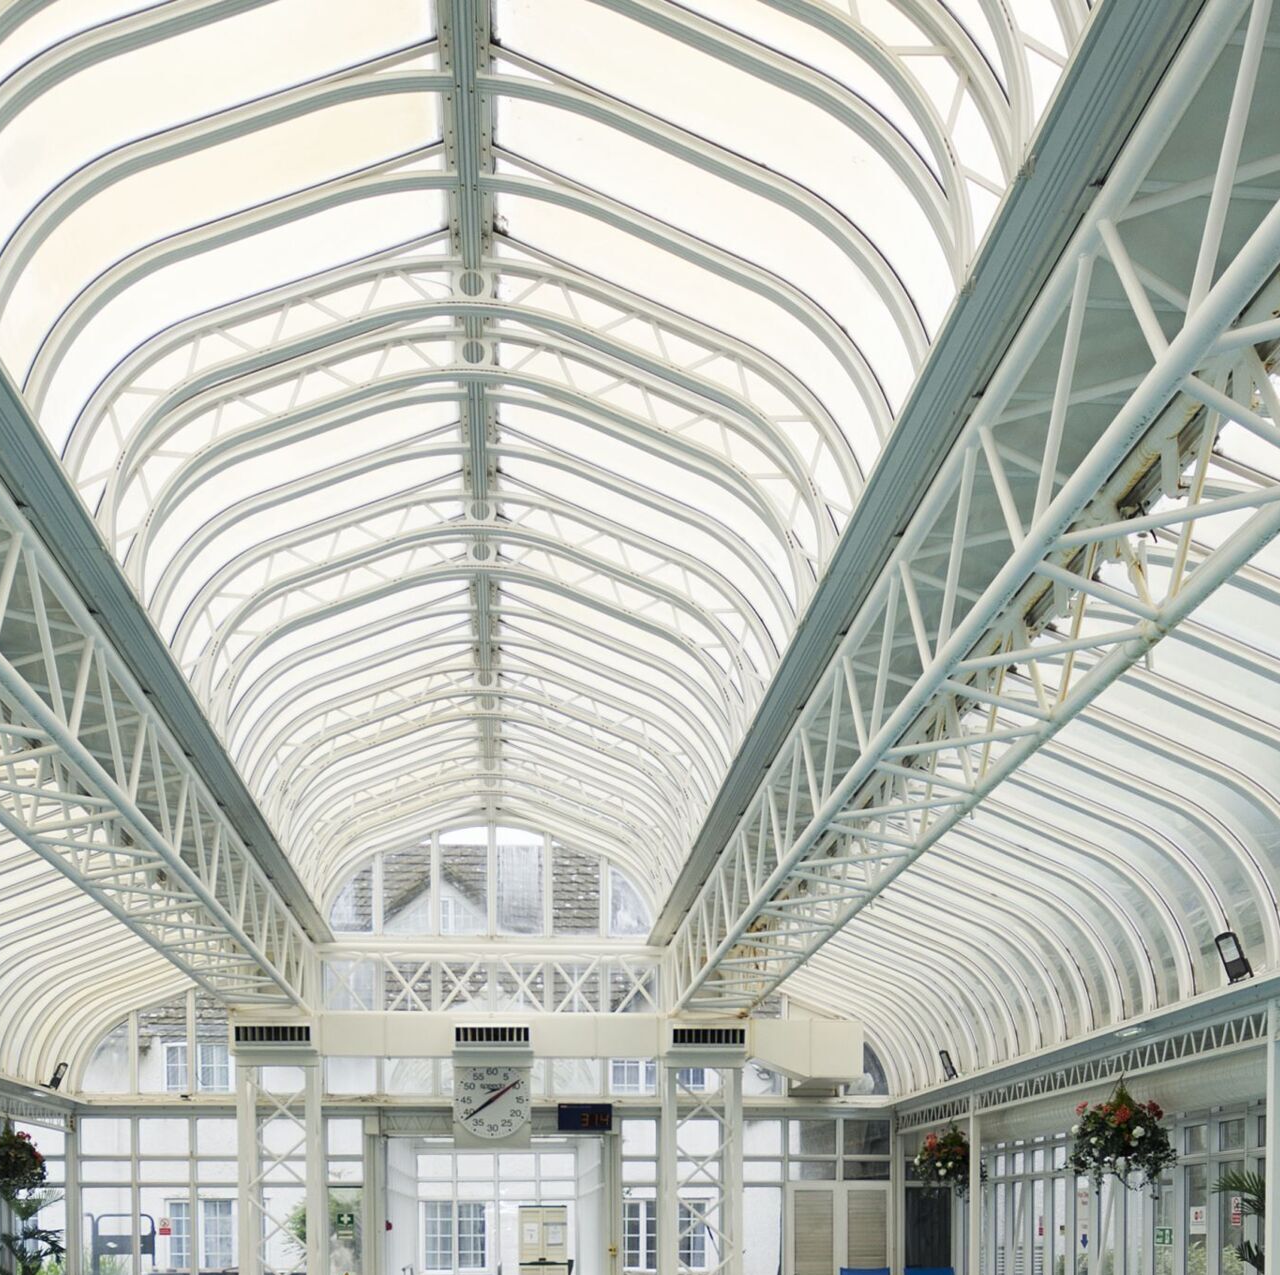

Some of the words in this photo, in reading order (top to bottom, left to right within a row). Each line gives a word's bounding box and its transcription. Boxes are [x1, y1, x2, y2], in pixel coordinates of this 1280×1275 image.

[486, 1067, 498, 1076] 60
[472, 1072, 484, 1080] 55
[503, 1072, 509, 1081] 5
[460, 1096, 472, 1104] 45
[515, 1096, 524, 1104] 15
[487, 1124, 499, 1132] 30
